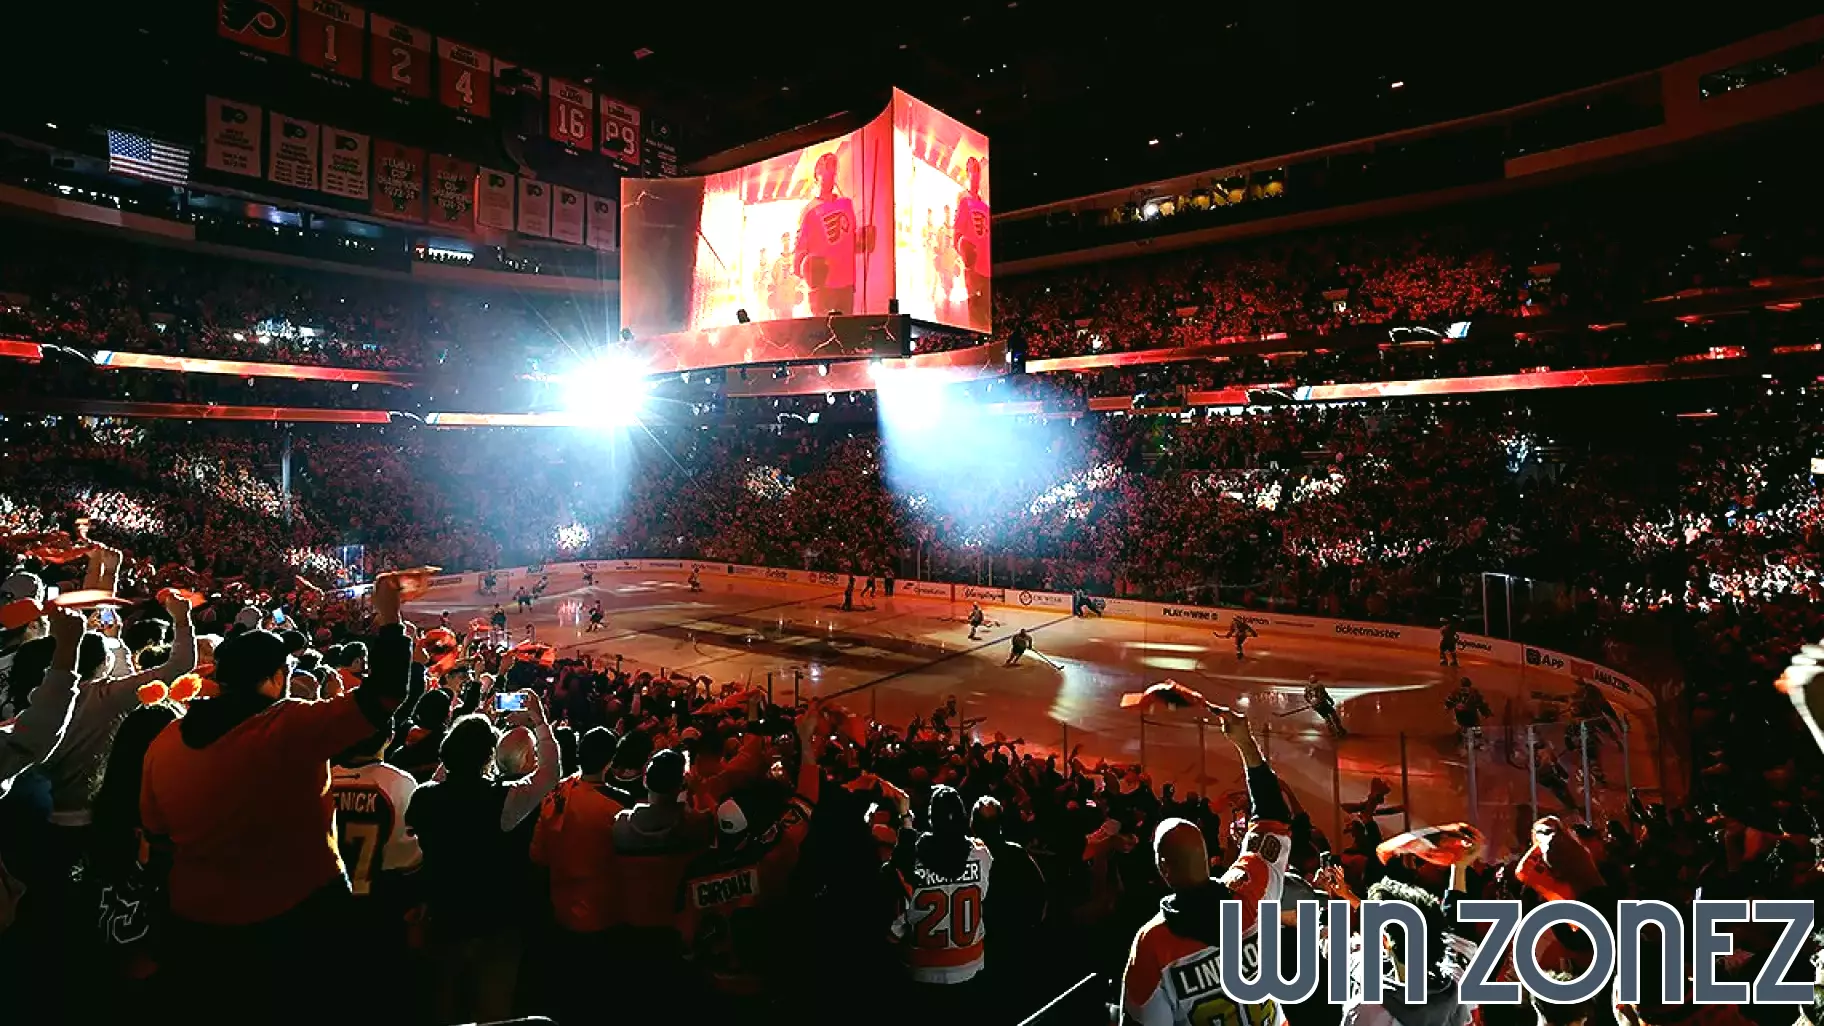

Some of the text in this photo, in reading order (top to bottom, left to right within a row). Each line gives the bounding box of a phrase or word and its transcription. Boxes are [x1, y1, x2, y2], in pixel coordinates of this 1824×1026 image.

[325, 25, 337, 62] 1
[391, 47, 412, 85] 2
[455, 71, 473, 104] 4
[558, 103, 585, 139] 16
[1335, 623, 1401, 639] ticketmaster
[1541, 654, 1564, 668] App
[344, 822, 379, 895] 7
[914, 886, 982, 948] 20
